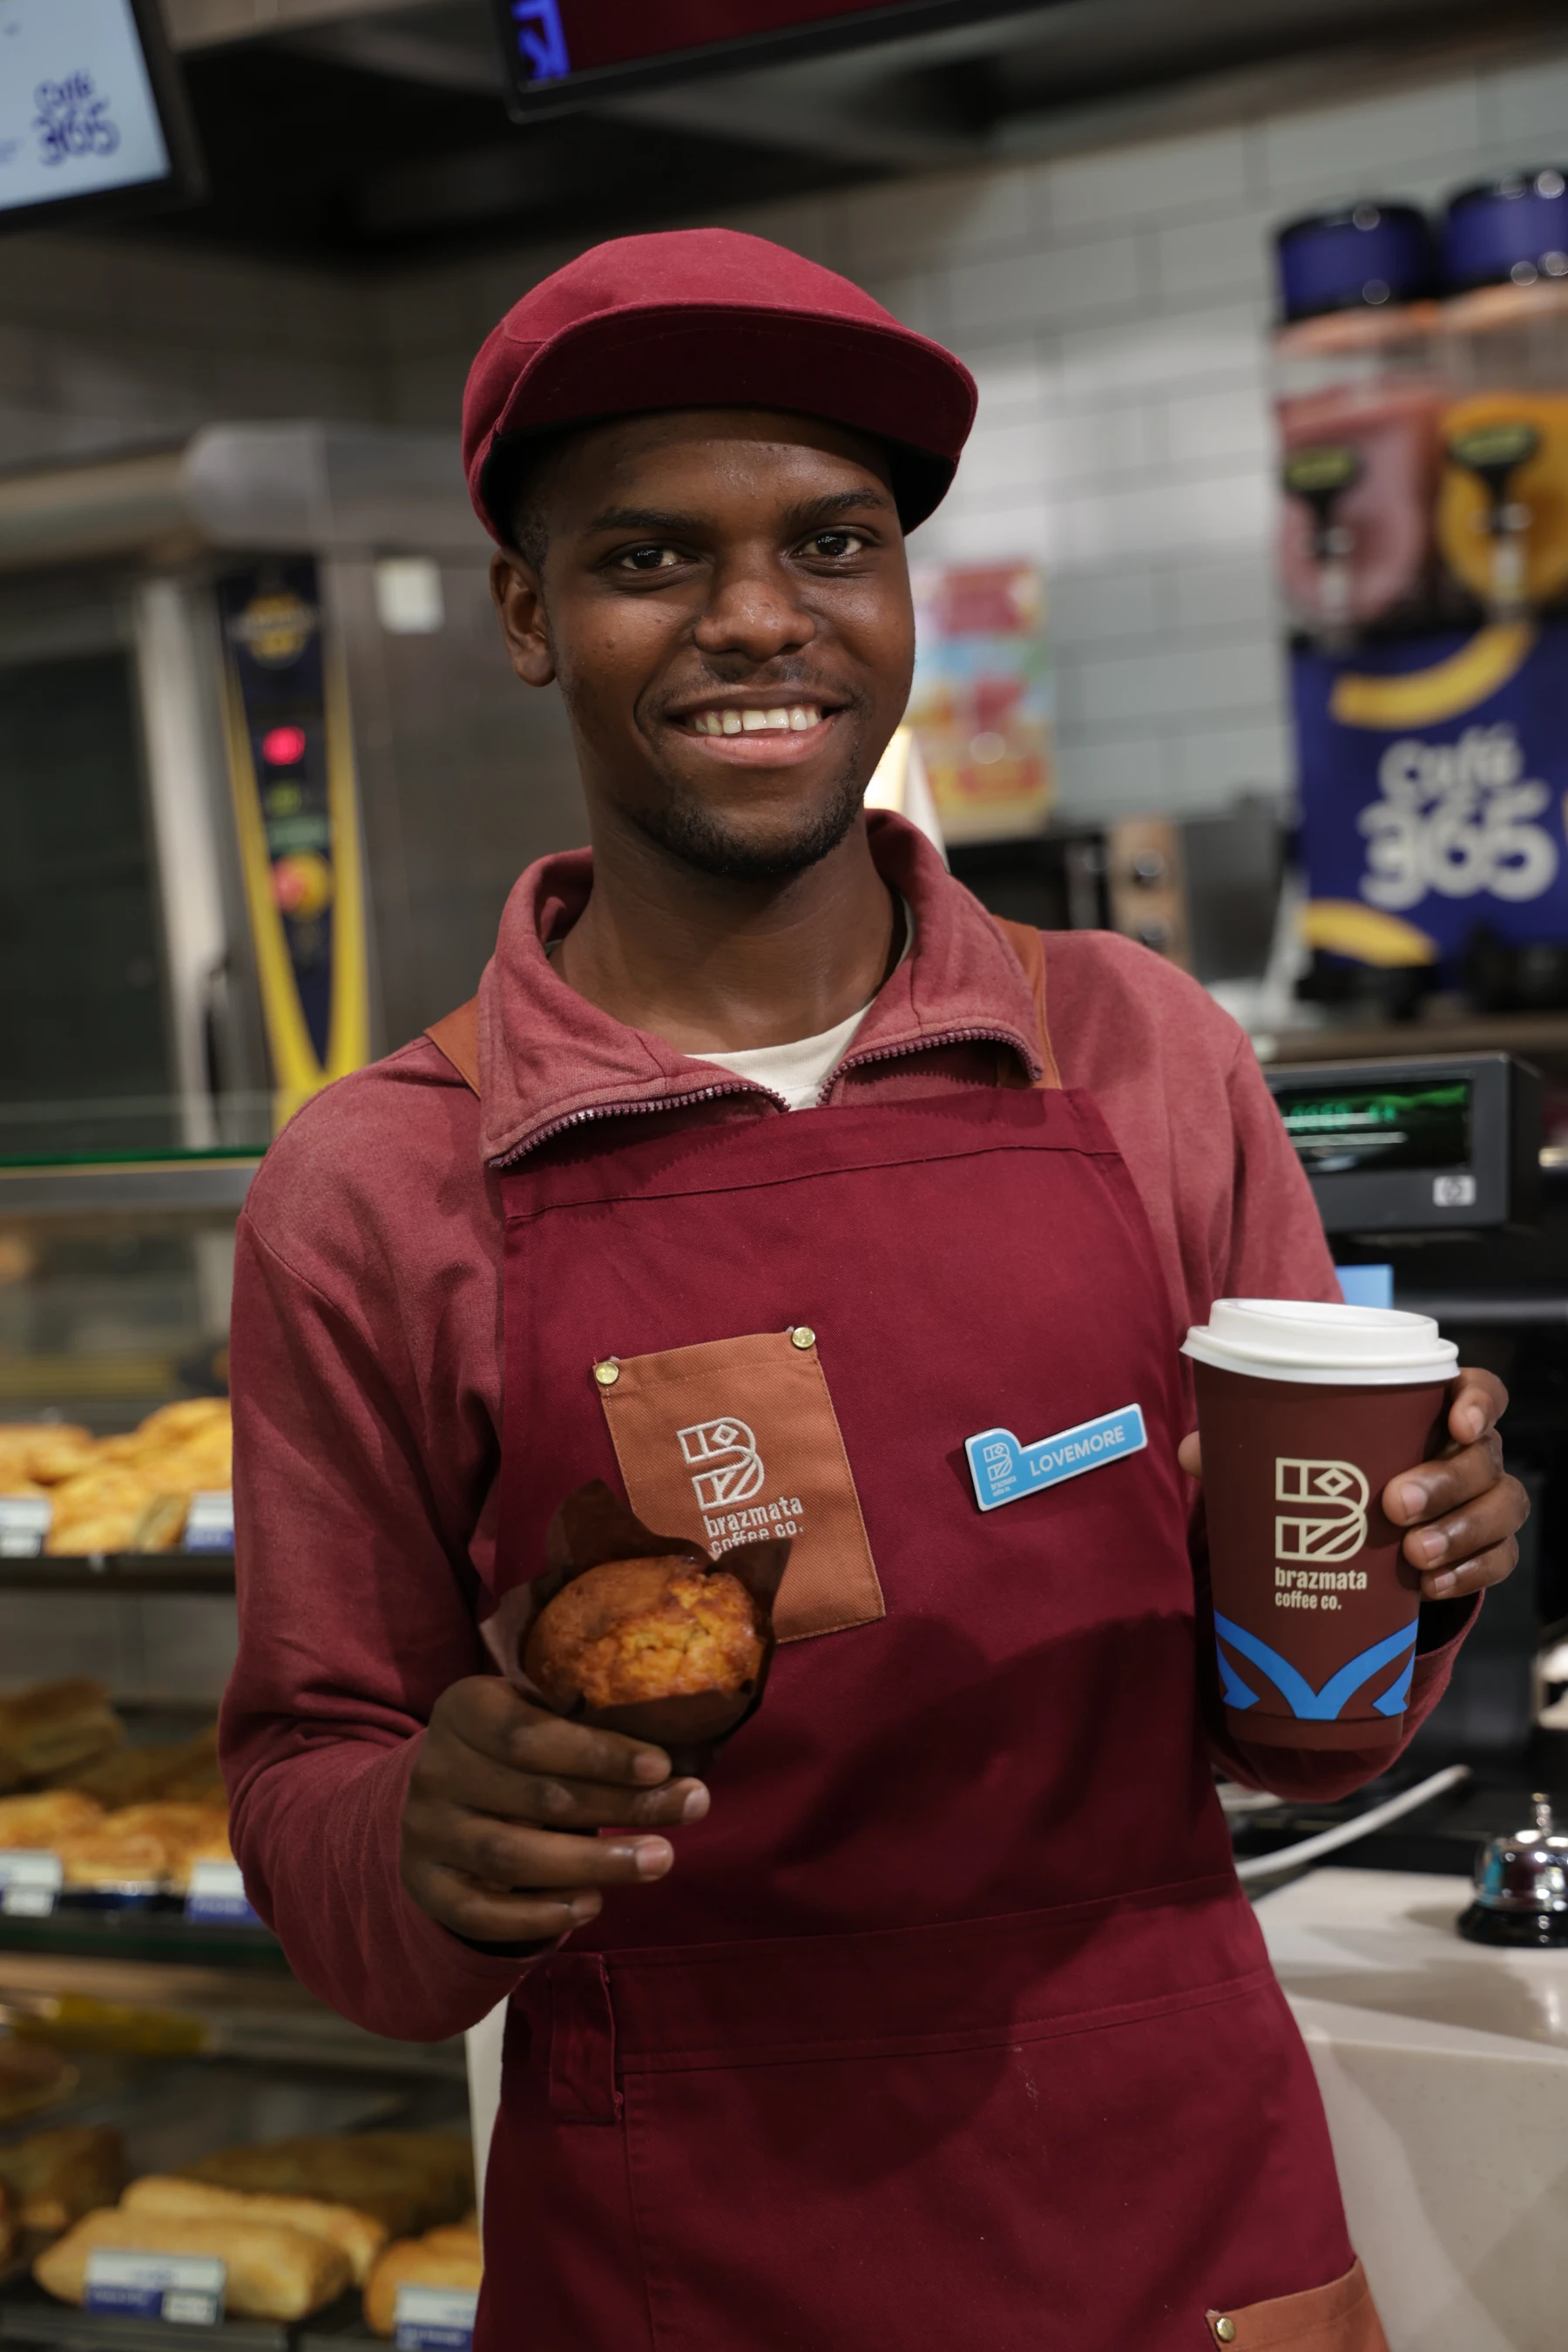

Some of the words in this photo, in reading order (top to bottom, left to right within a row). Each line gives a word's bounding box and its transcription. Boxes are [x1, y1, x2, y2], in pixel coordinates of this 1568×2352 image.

[1355, 780, 1560, 910] 365
[1029, 1425, 1125, 1477] LOVEMORE
[703, 1497, 803, 1538] brazmata
[774, 1520, 804, 1538] co.
[1274, 1566, 1368, 1590] brazmata
[1274, 1591, 1318, 1609] coffee
[1321, 1594, 1342, 1610] co.
